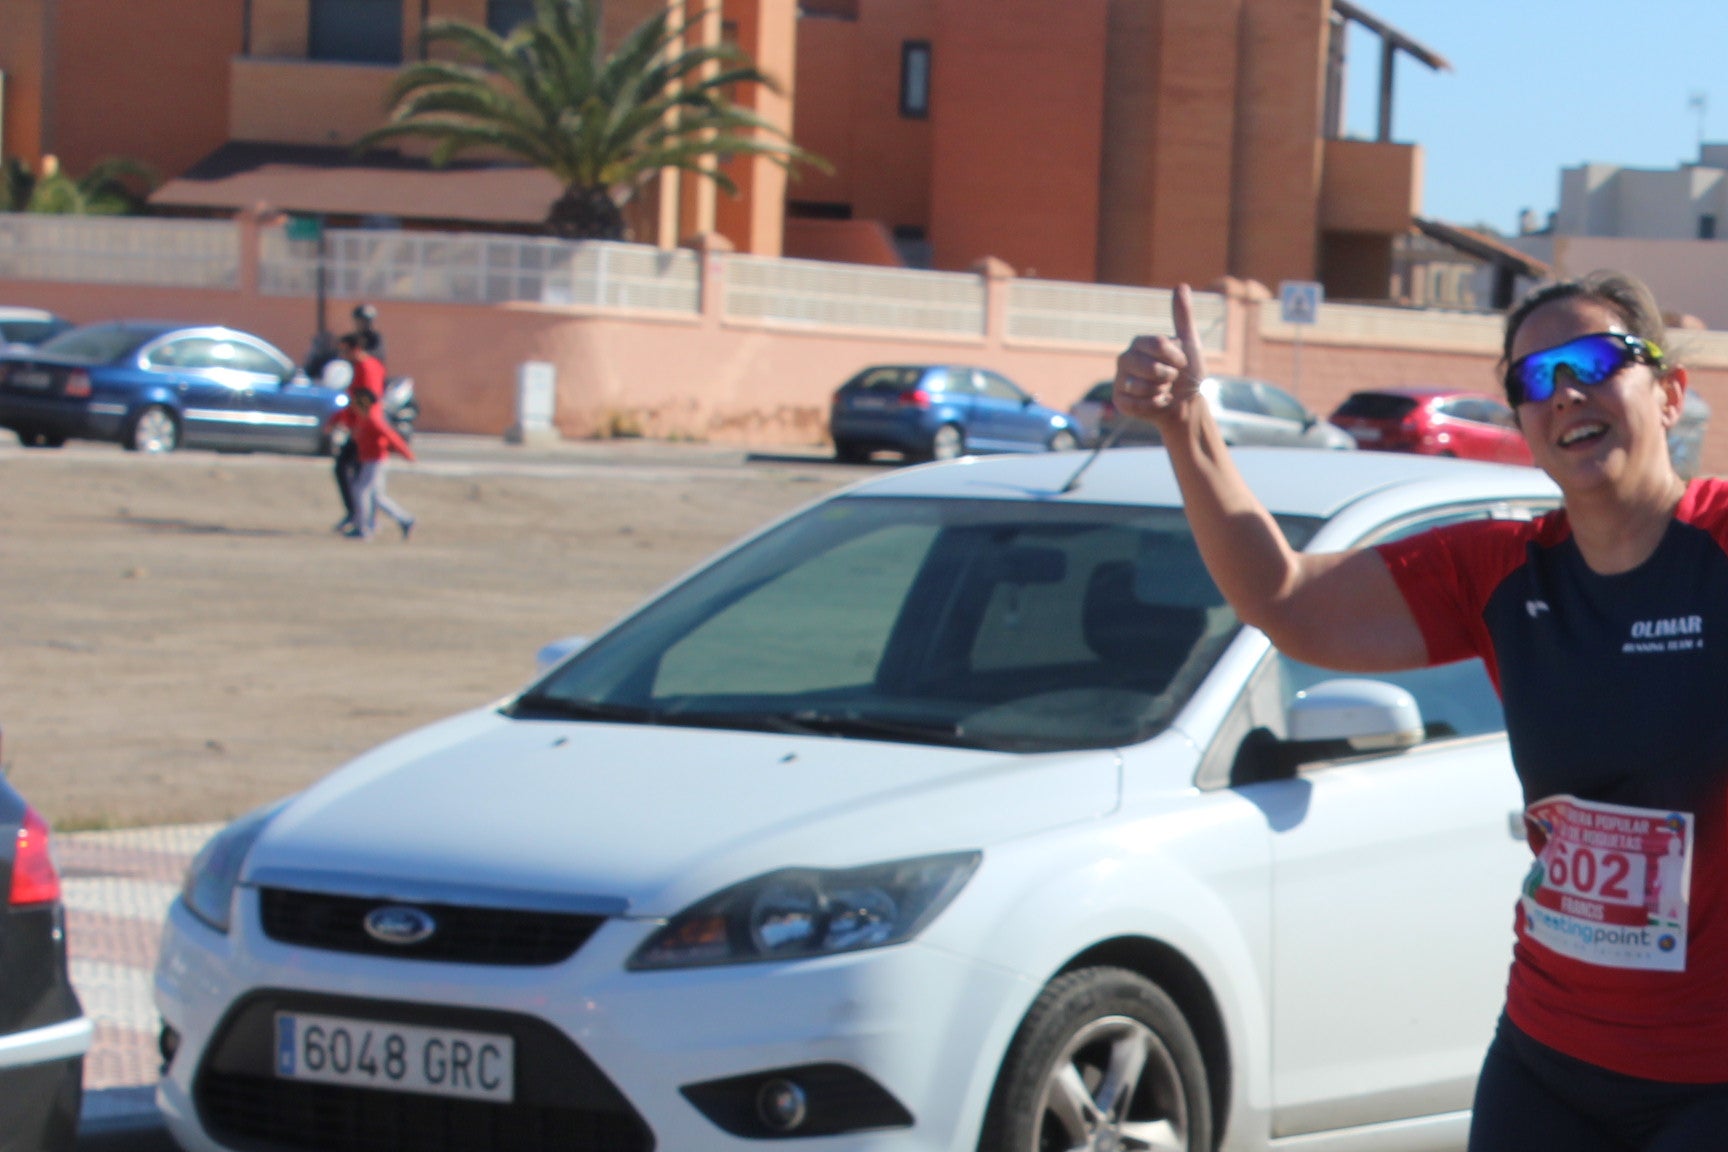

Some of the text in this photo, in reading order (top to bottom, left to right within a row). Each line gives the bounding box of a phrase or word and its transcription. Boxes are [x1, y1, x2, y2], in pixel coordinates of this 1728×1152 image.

[1631, 615, 1703, 638] OLIMAR
[304, 1024, 499, 1091] 6048 GRC
